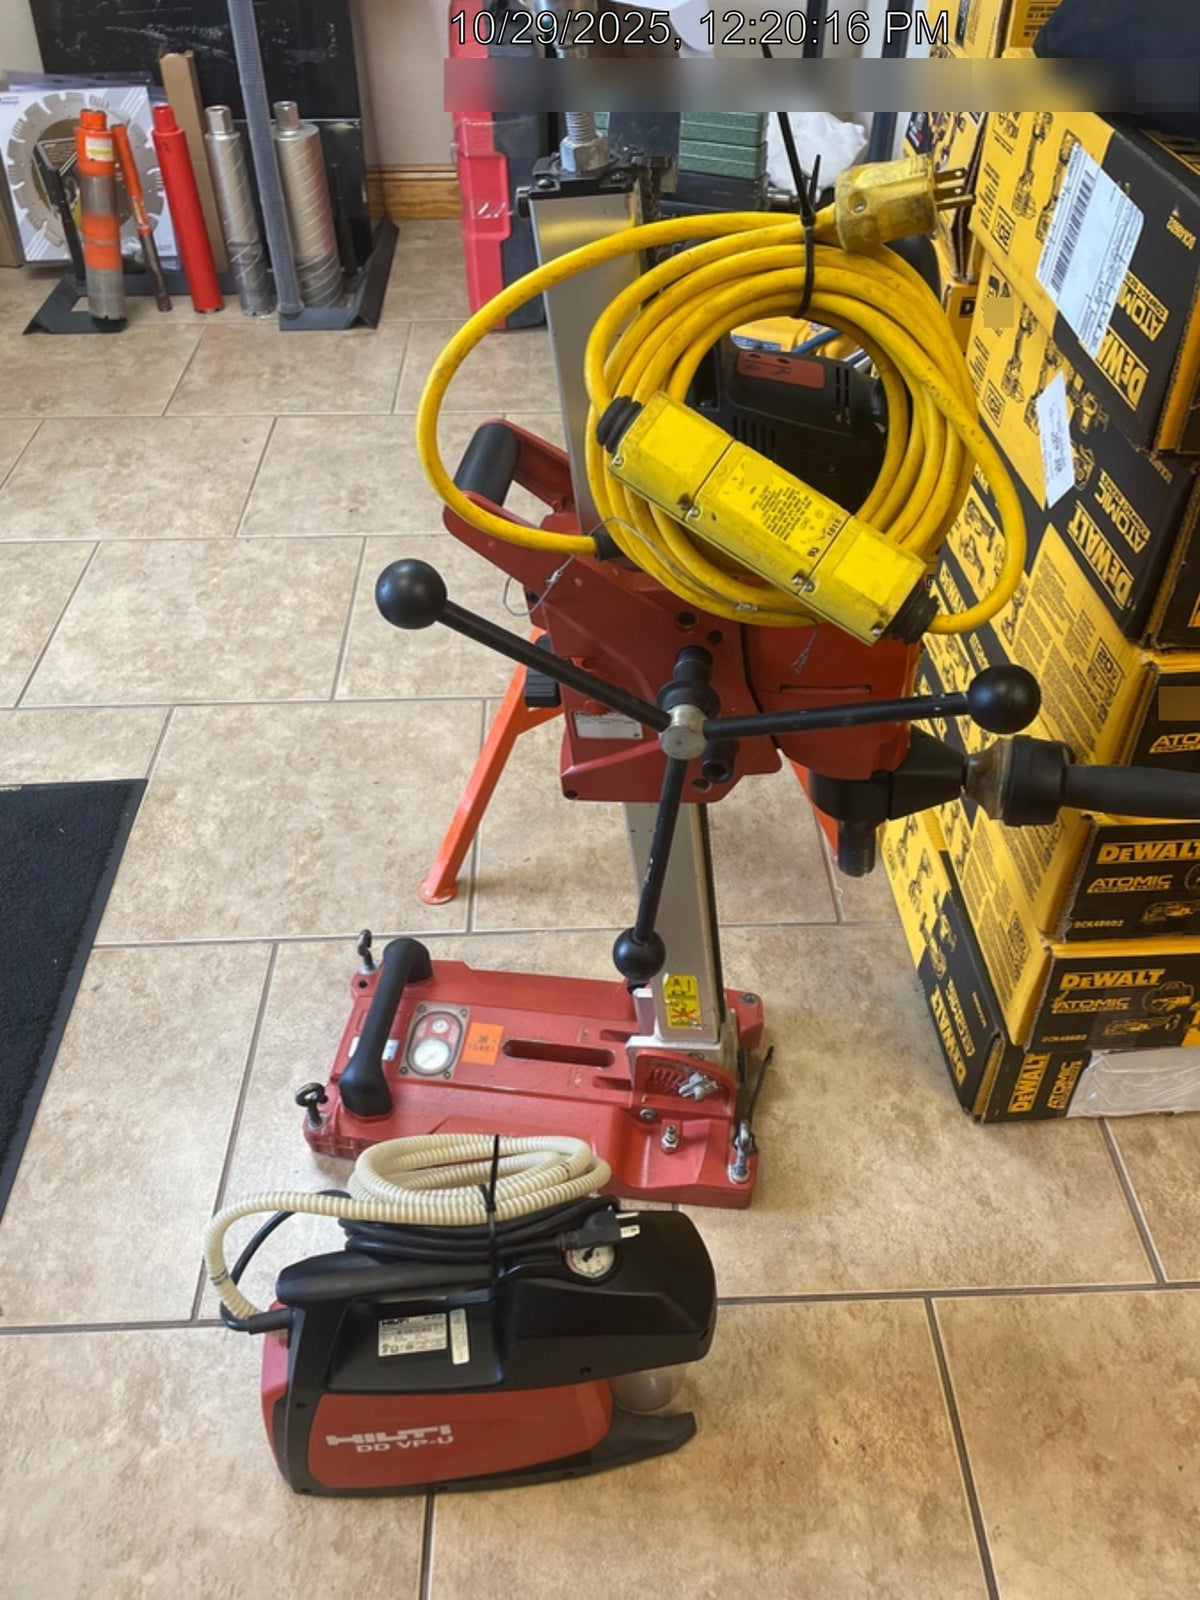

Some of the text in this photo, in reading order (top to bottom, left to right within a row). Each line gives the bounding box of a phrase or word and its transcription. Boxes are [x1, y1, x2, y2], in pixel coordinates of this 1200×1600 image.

[1094, 480, 1148, 555] ATOMIC
[1149, 733, 1200, 754] ATO
[1087, 874, 1174, 894] ATOMIC
[1059, 968, 1167, 991] DEWALT
[1052, 997, 1132, 1014] ATOMIC
[325, 1423, 452, 1447] HILTI
[356, 1435, 454, 1454] DD VP-U
